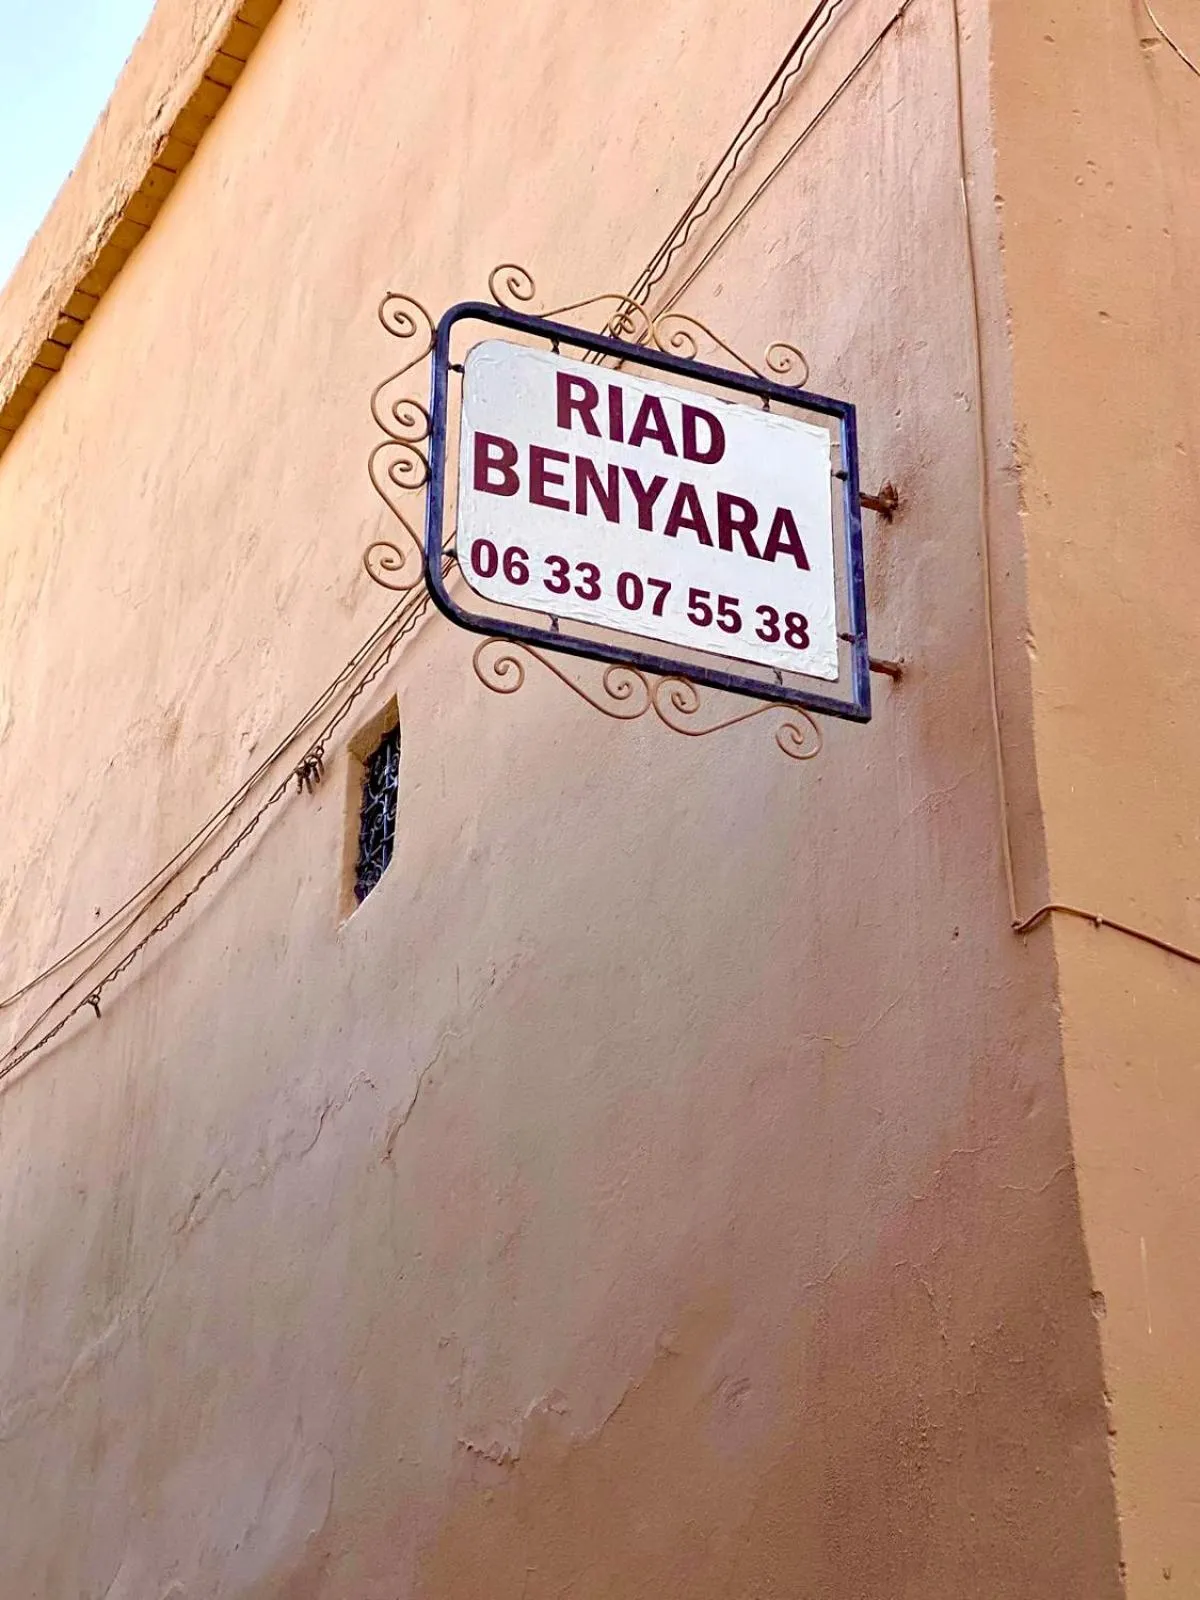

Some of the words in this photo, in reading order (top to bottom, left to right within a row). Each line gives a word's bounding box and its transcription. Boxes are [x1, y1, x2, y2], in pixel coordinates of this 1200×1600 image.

[556, 370, 726, 465] RIAD
[473, 430, 811, 572] BENYARA
[470, 538, 531, 586] 06
[542, 554, 602, 602] 33
[616, 571, 672, 617] 07
[686, 587, 743, 635] 55
[755, 604, 811, 651] 38
